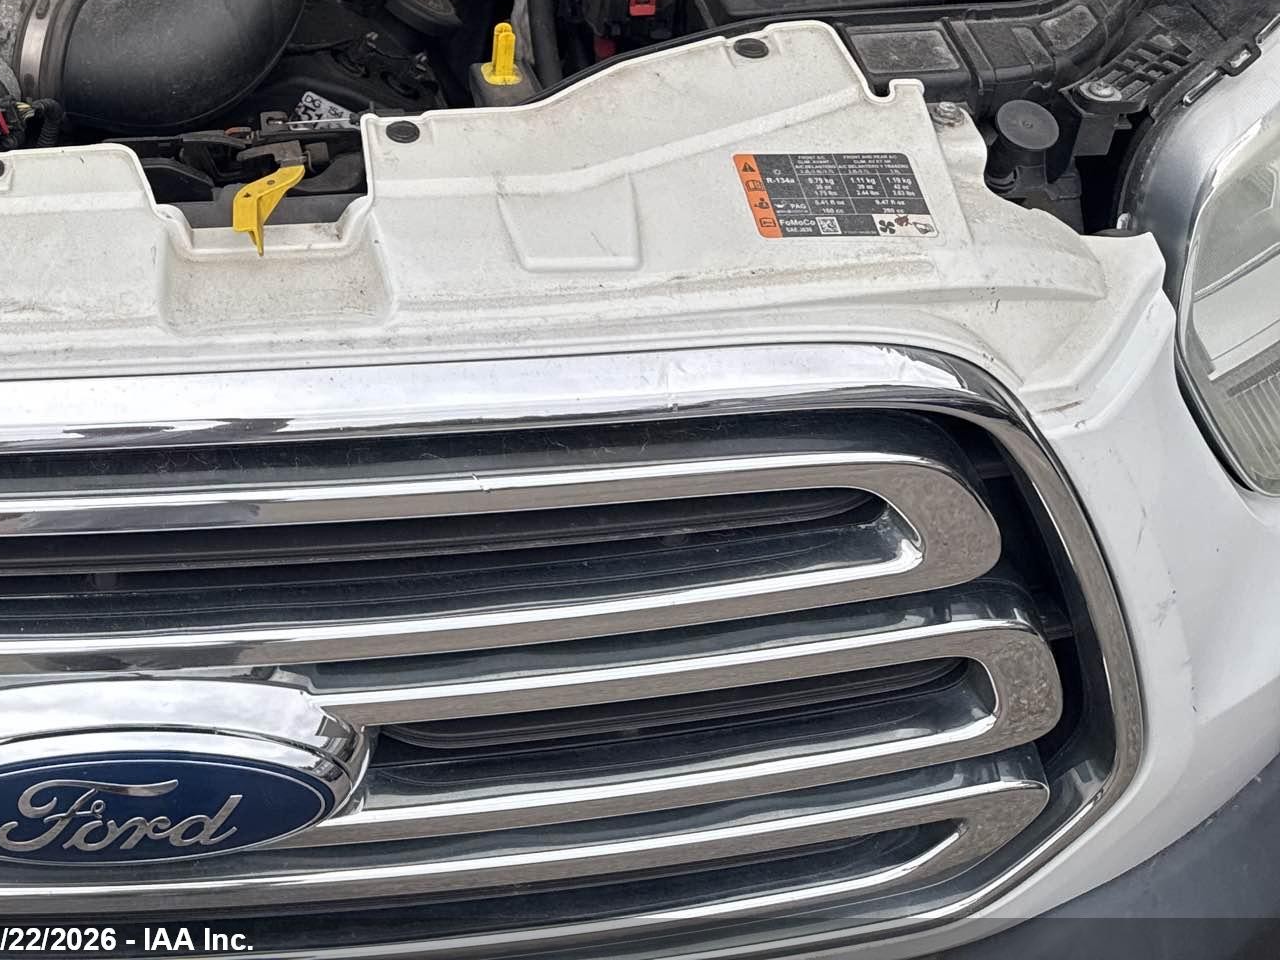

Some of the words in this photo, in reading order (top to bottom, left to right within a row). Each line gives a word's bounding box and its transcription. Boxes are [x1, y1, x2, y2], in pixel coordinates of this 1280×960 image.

[304, 94, 322, 109] DG
[824, 177, 835, 185] kg
[866, 177, 876, 185] kg
[902, 177, 912, 185] kg
